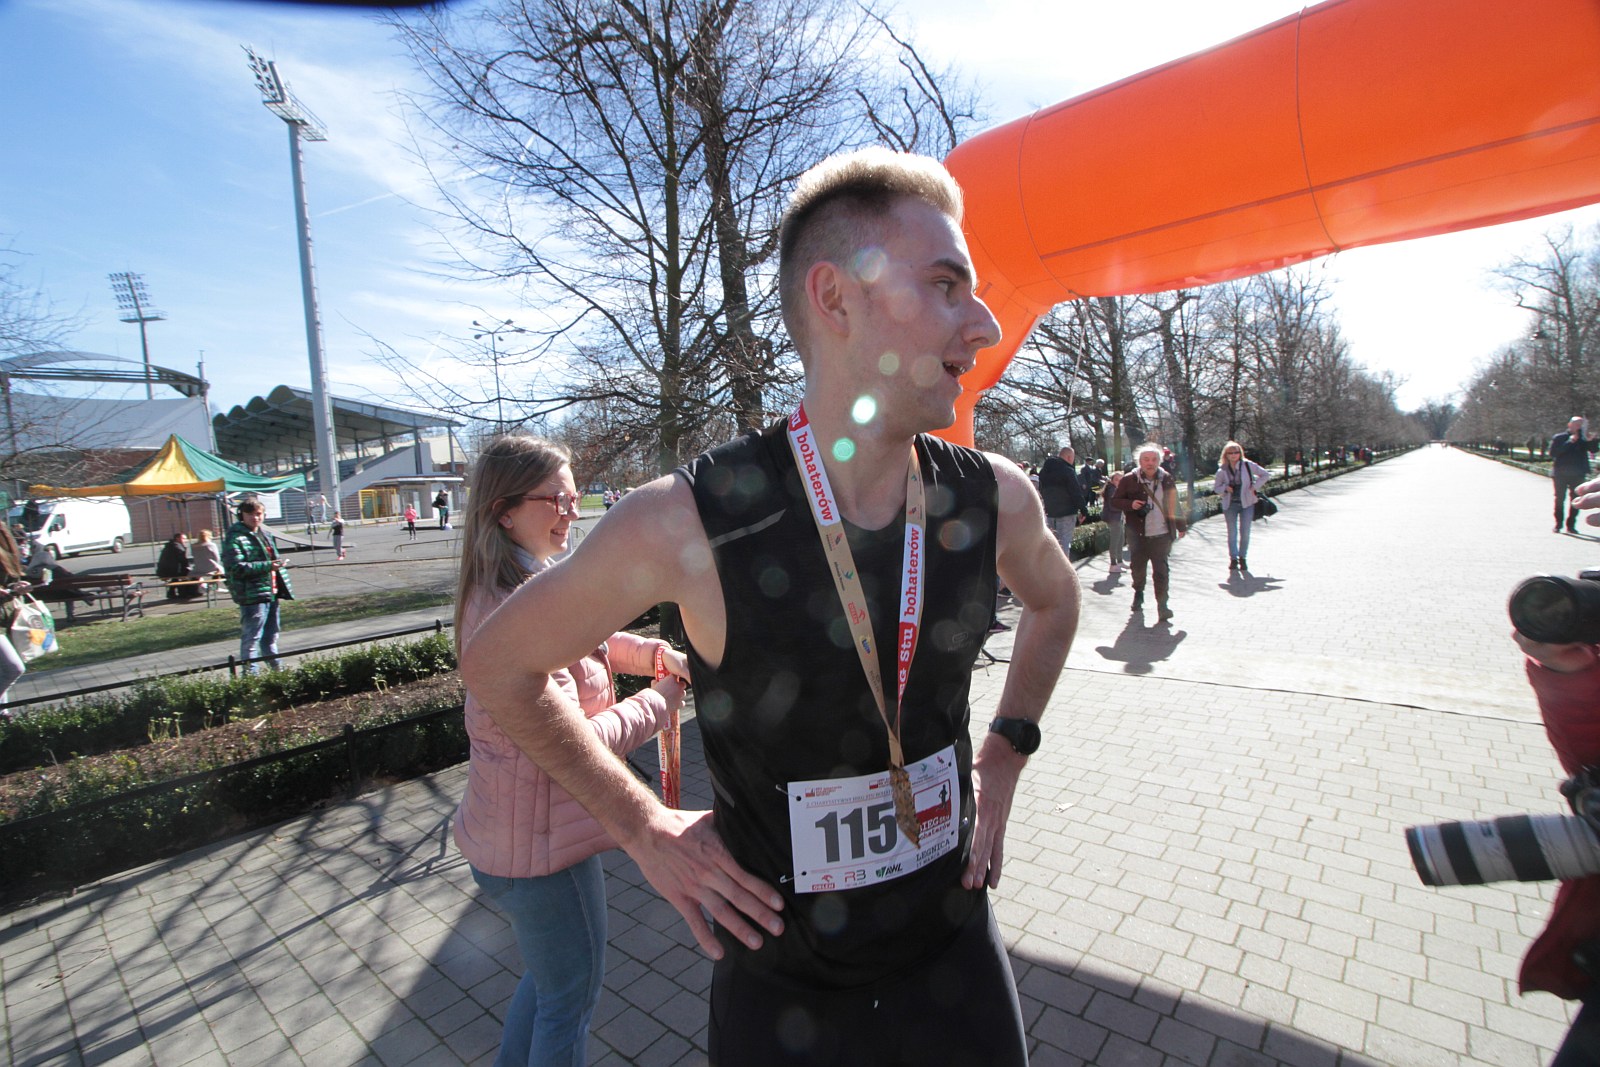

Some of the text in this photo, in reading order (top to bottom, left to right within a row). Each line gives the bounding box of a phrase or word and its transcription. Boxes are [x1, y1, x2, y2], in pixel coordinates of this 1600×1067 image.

[796, 431, 834, 521] bohaterów
[904, 528, 920, 616] bohaterów
[900, 628, 914, 662] Stu
[815, 800, 898, 864] 115
[916, 839, 950, 862] LEGNICA
